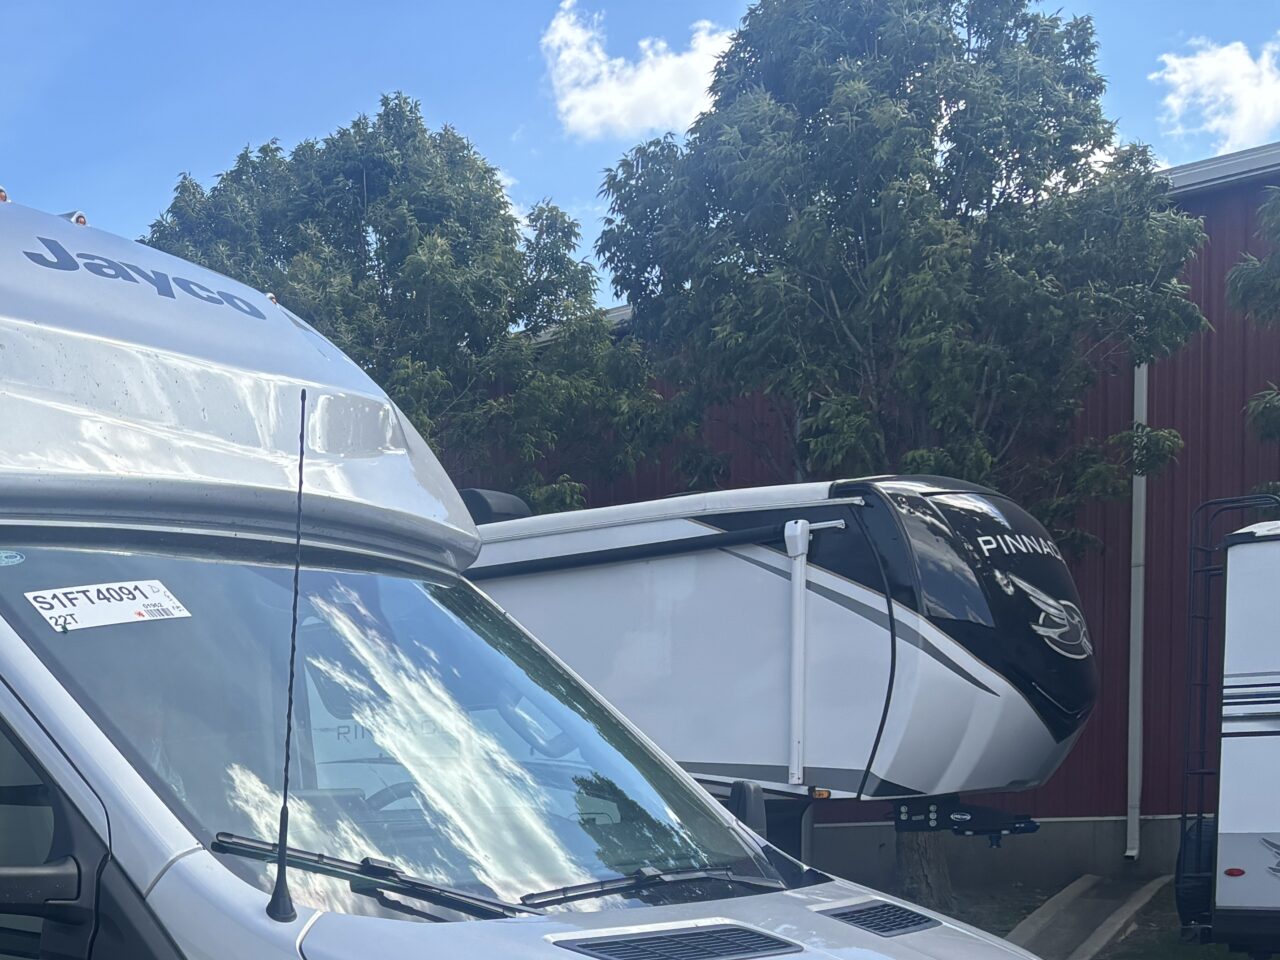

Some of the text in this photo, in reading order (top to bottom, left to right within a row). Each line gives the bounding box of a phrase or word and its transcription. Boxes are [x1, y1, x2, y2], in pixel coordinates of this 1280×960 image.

[22, 236, 267, 320] Jayco
[32, 585, 149, 611] S1FT4091
[49, 613, 78, 627] 22T
